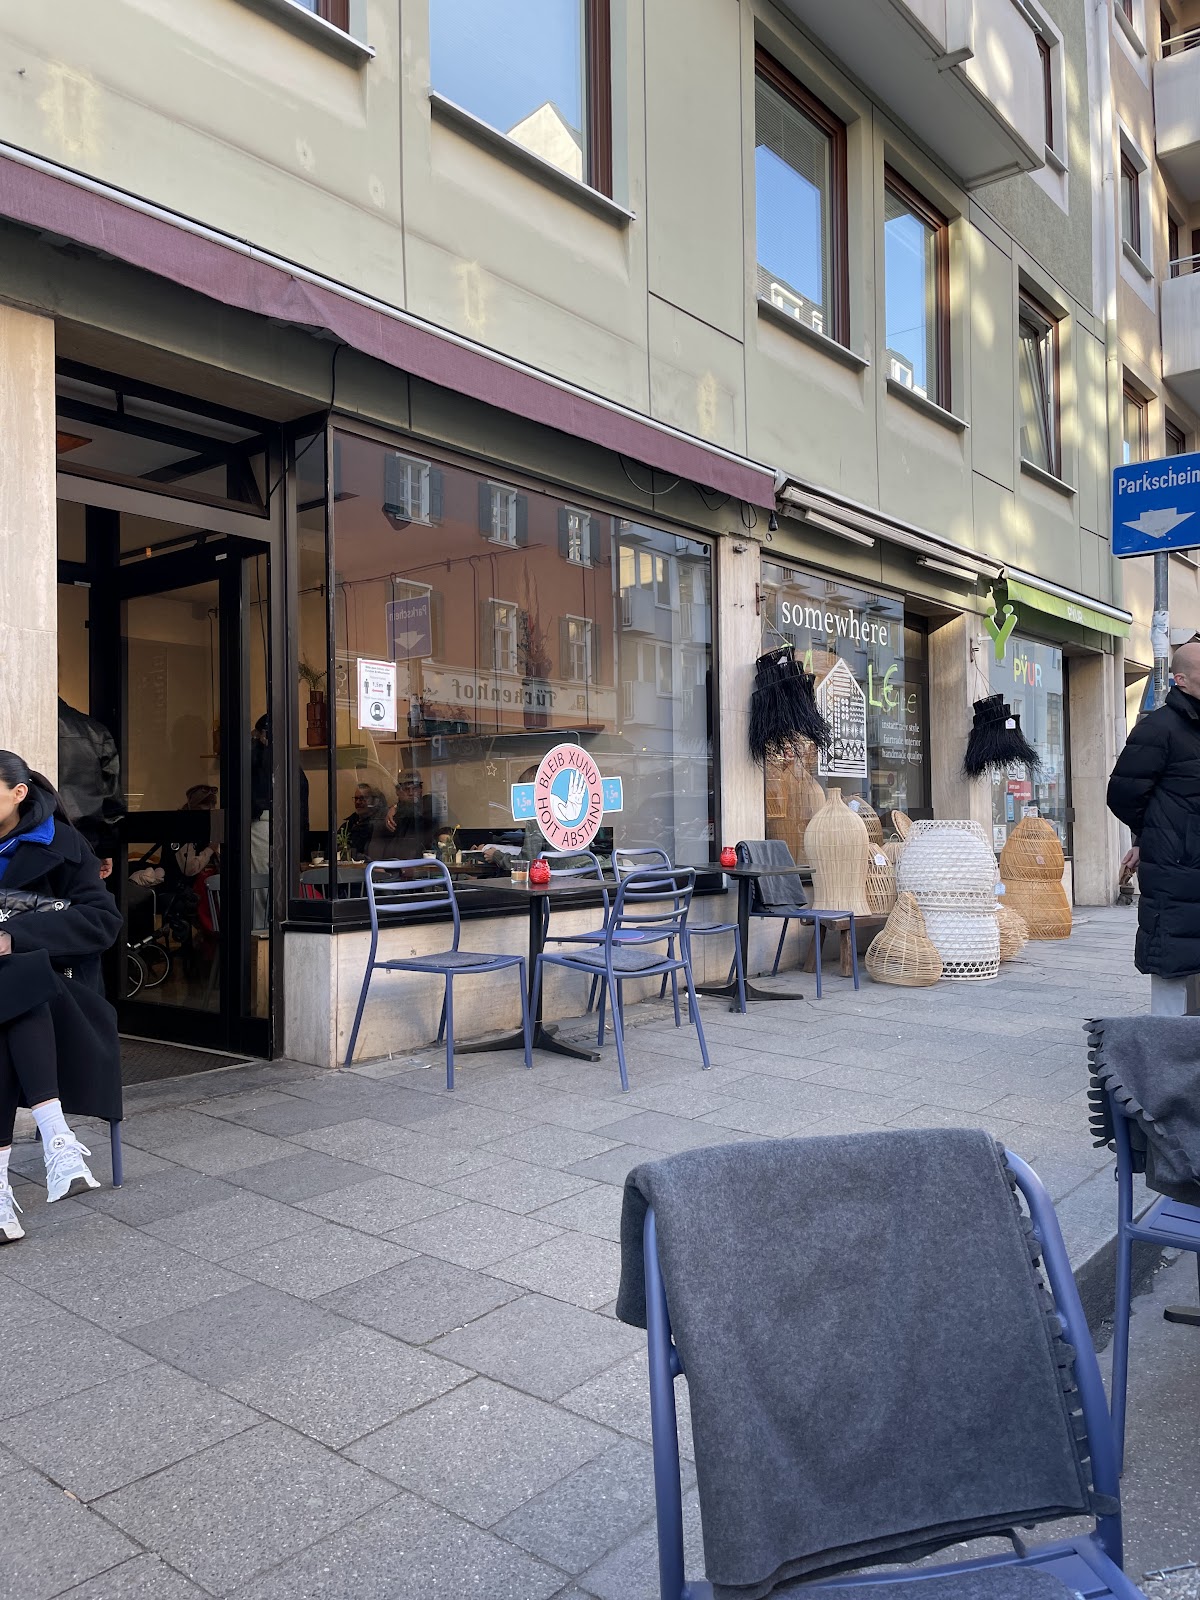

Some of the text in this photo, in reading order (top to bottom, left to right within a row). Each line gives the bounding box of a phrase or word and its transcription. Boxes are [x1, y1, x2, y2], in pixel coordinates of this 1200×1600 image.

[1118, 467, 1200, 495] Parkschein
[781, 601, 888, 646] somewhere
[1013, 654, 1043, 688] PŸUR
[883, 733, 904, 745] fairtrade
[908, 722, 920, 735] style
[881, 747, 907, 759] handmade
[539, 751, 597, 789] BLEIB XUND
[537, 792, 601, 847] HOIT ABSTAND
